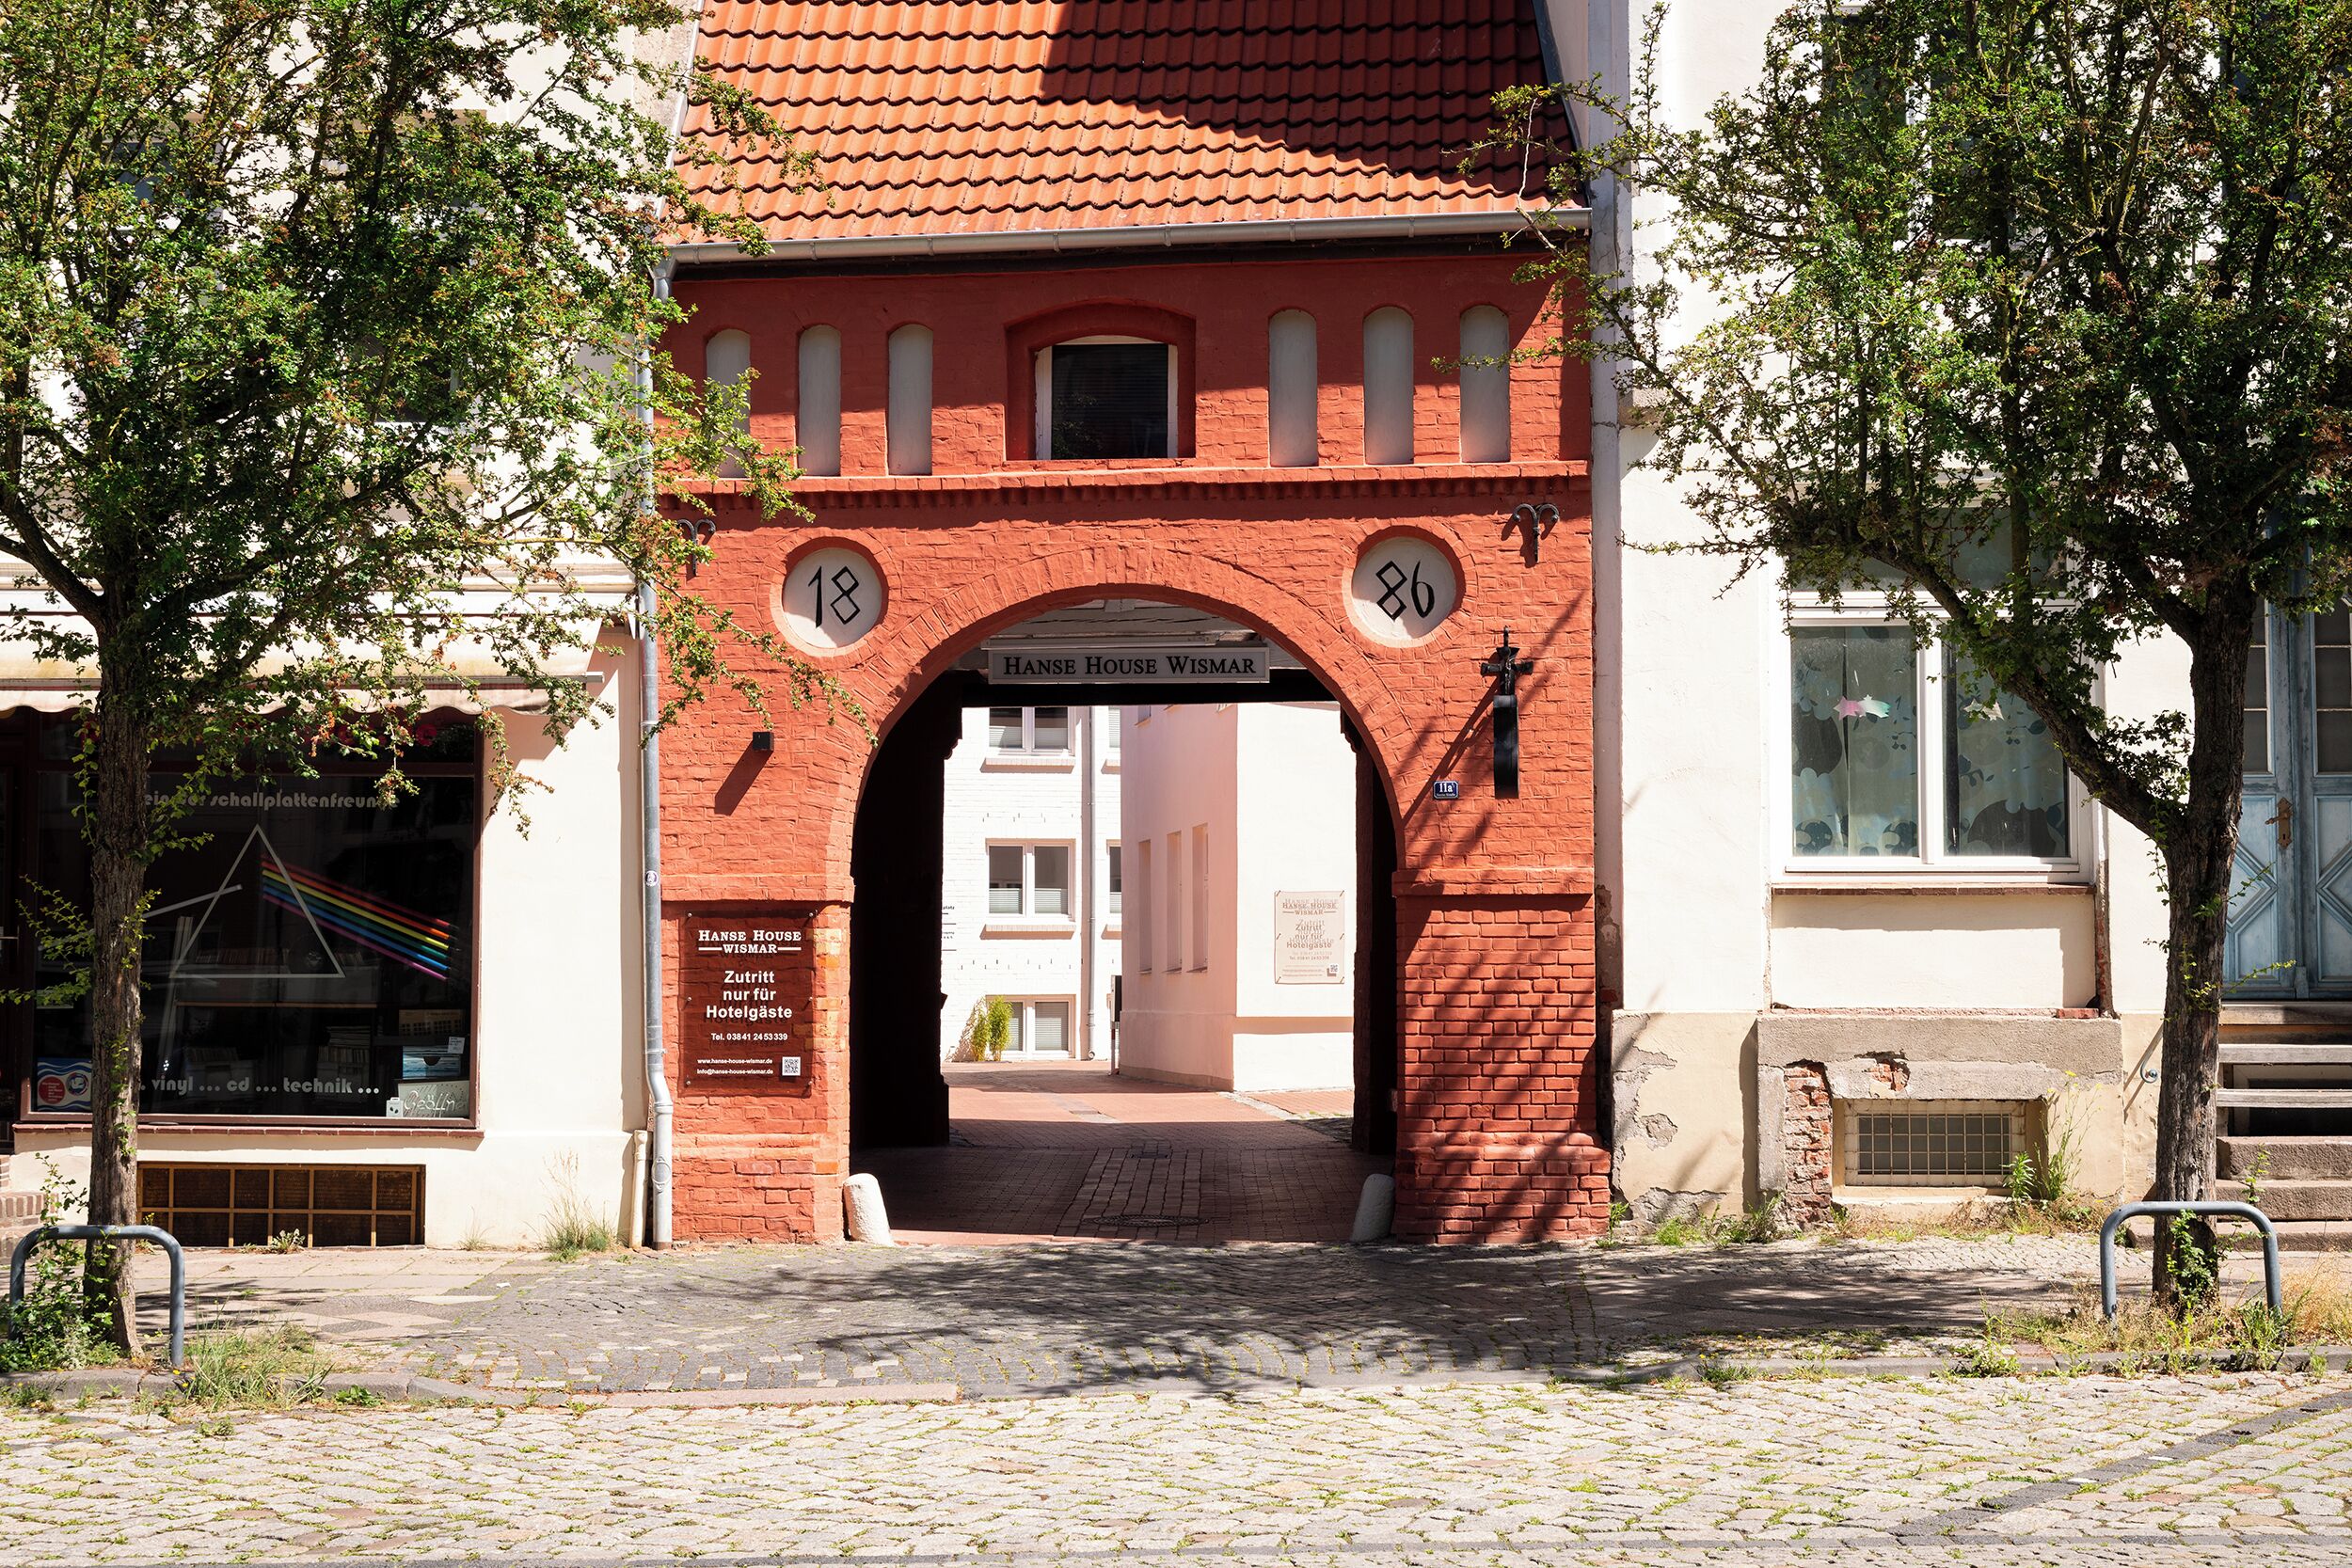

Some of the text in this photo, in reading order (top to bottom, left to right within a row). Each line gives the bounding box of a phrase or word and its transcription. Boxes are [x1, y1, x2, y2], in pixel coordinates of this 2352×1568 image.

[808, 565, 861, 628] 18
[1375, 560, 1435, 622] 86
[1003, 656, 1256, 675] HANSE HOUSE WISMAR
[698, 930, 802, 942] HANSE HOUSE
[723, 943, 777, 953] WISMAR
[724, 970, 775, 983] Zutritt
[723, 988, 776, 1001] nur für
[706, 1006, 792, 1021] Hotelgäste
[151, 1075, 194, 1095] vinyl
[227, 1077, 250, 1092] cd
[283, 1077, 353, 1094] technik
